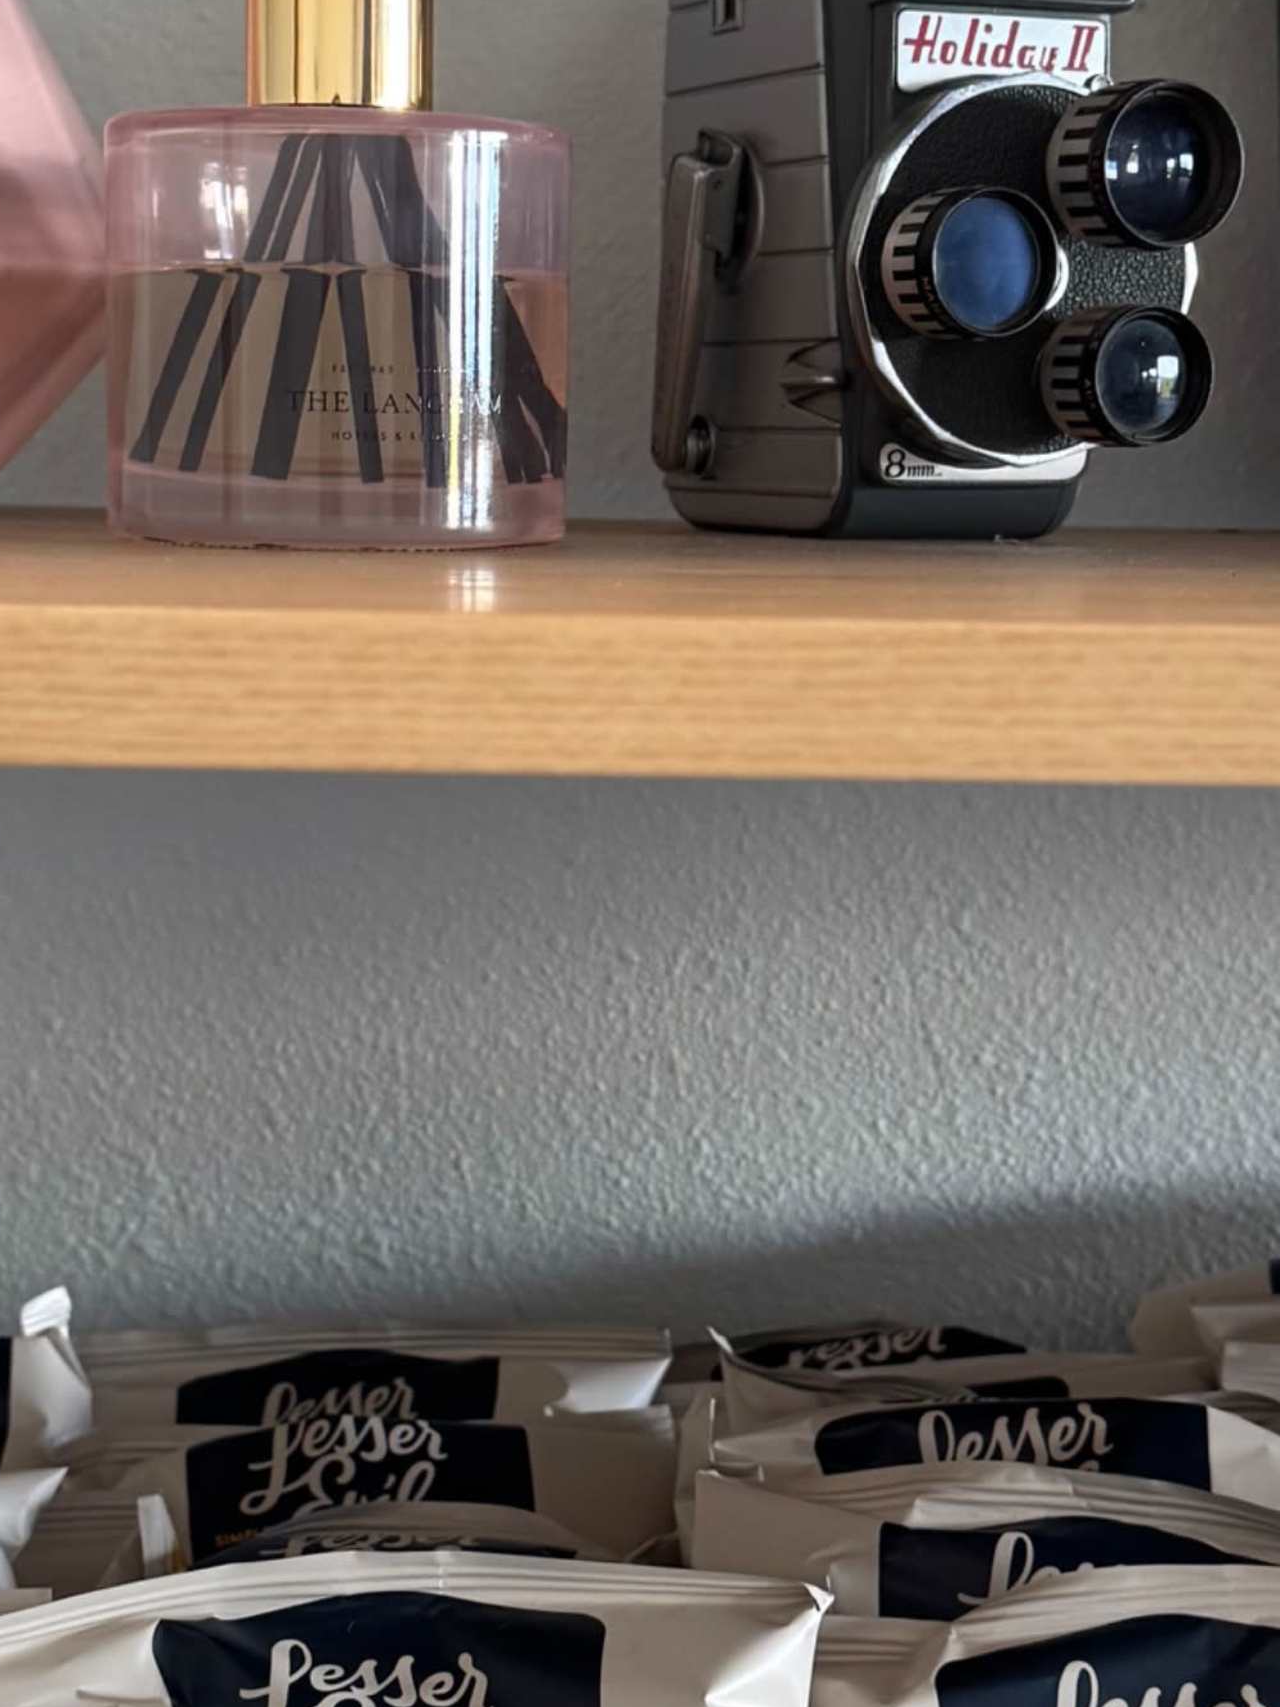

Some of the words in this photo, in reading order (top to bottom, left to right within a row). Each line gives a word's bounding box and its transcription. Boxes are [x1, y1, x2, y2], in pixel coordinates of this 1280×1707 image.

[904, 15, 1059, 73] Holiday
[1062, 25, 1099, 72] II
[288, 390, 350, 413] THE
[239, 1413, 448, 1516] Lesser
